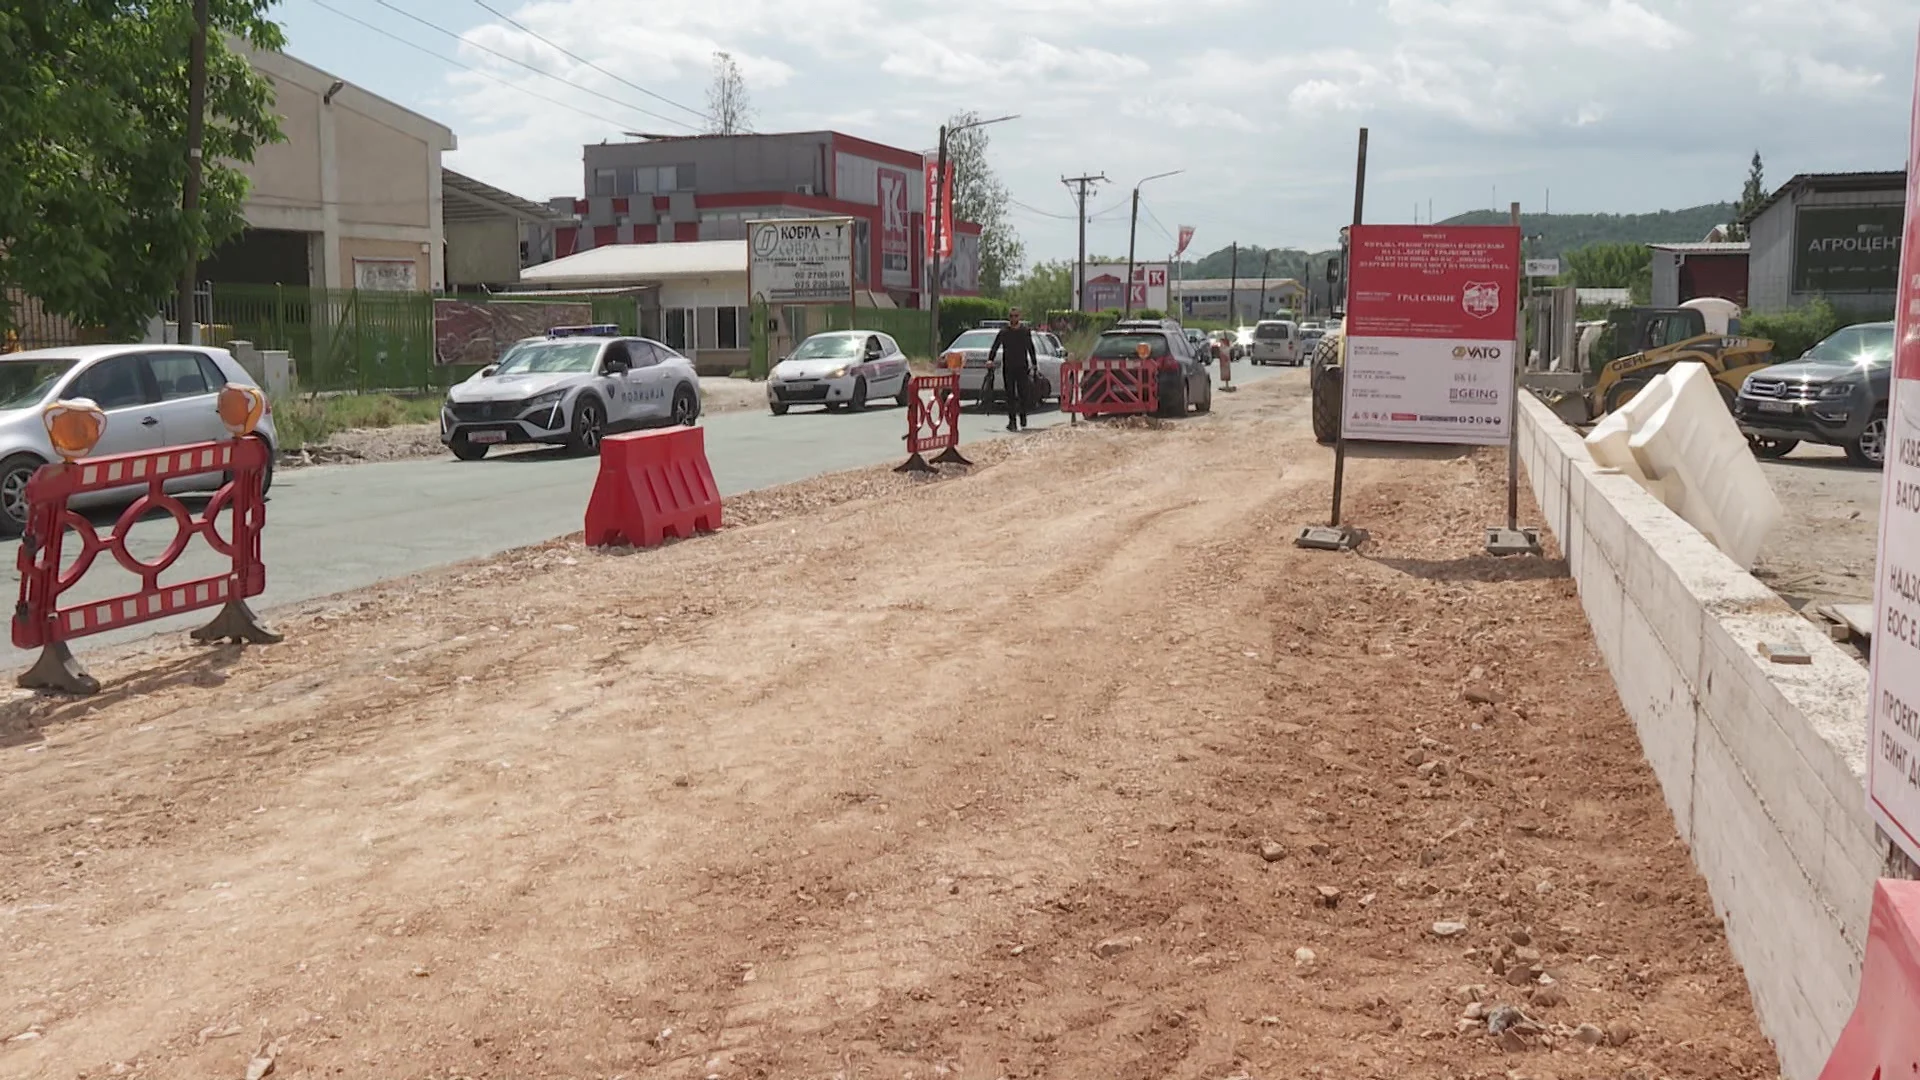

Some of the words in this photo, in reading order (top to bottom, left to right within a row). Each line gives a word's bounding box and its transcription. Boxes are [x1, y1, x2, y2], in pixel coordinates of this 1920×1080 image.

[781, 226, 820, 240] КОБРА
[1808, 236, 1904, 253] АГРОЦЕН
[1467, 346, 1501, 359] VATO
[1612, 353, 1652, 371] GEHL
[1459, 388, 1498, 399] GEING
